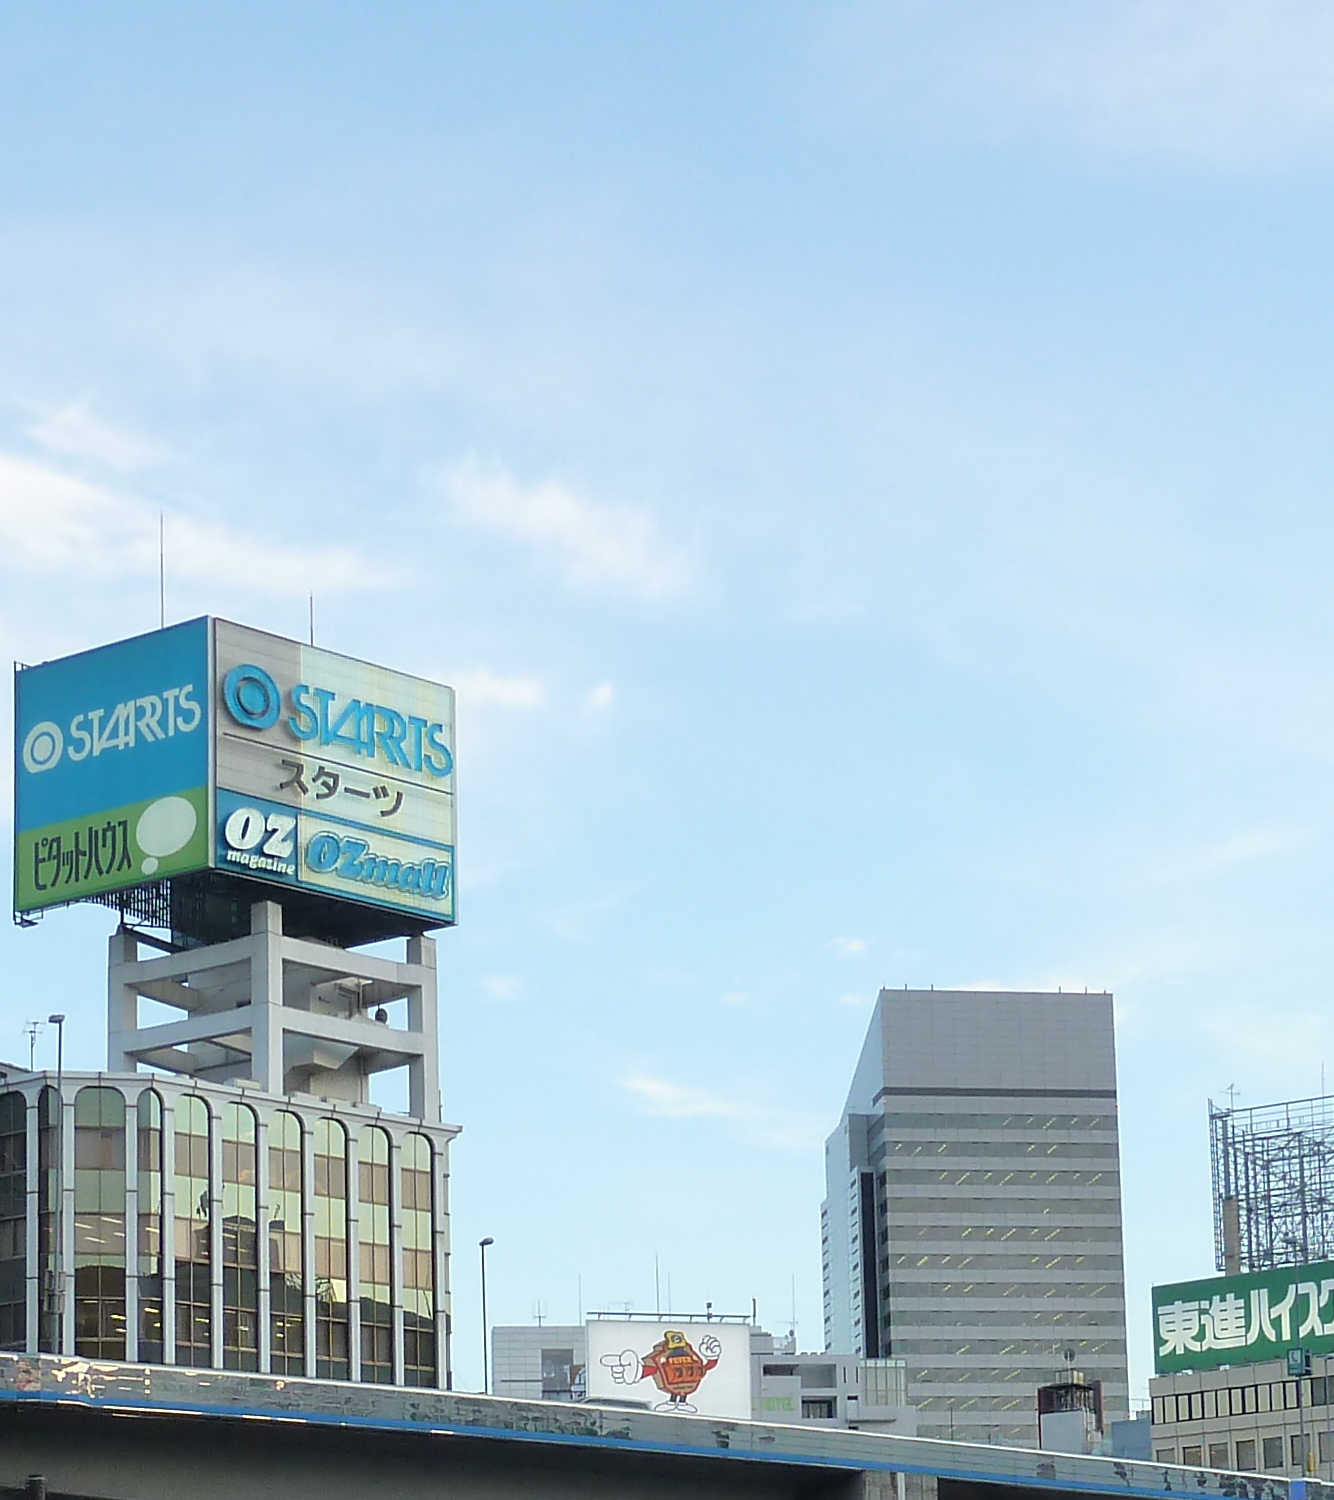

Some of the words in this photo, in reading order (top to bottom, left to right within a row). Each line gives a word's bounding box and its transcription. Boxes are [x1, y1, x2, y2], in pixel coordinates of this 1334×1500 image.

[68, 684, 202, 761] STARTS
[288, 684, 453, 778] STARTS
[279, 759, 403, 817] スターツ
[33, 819, 133, 891] ピタットハウス
[224, 806, 297, 859] OZ
[226, 848, 296, 875] magazine
